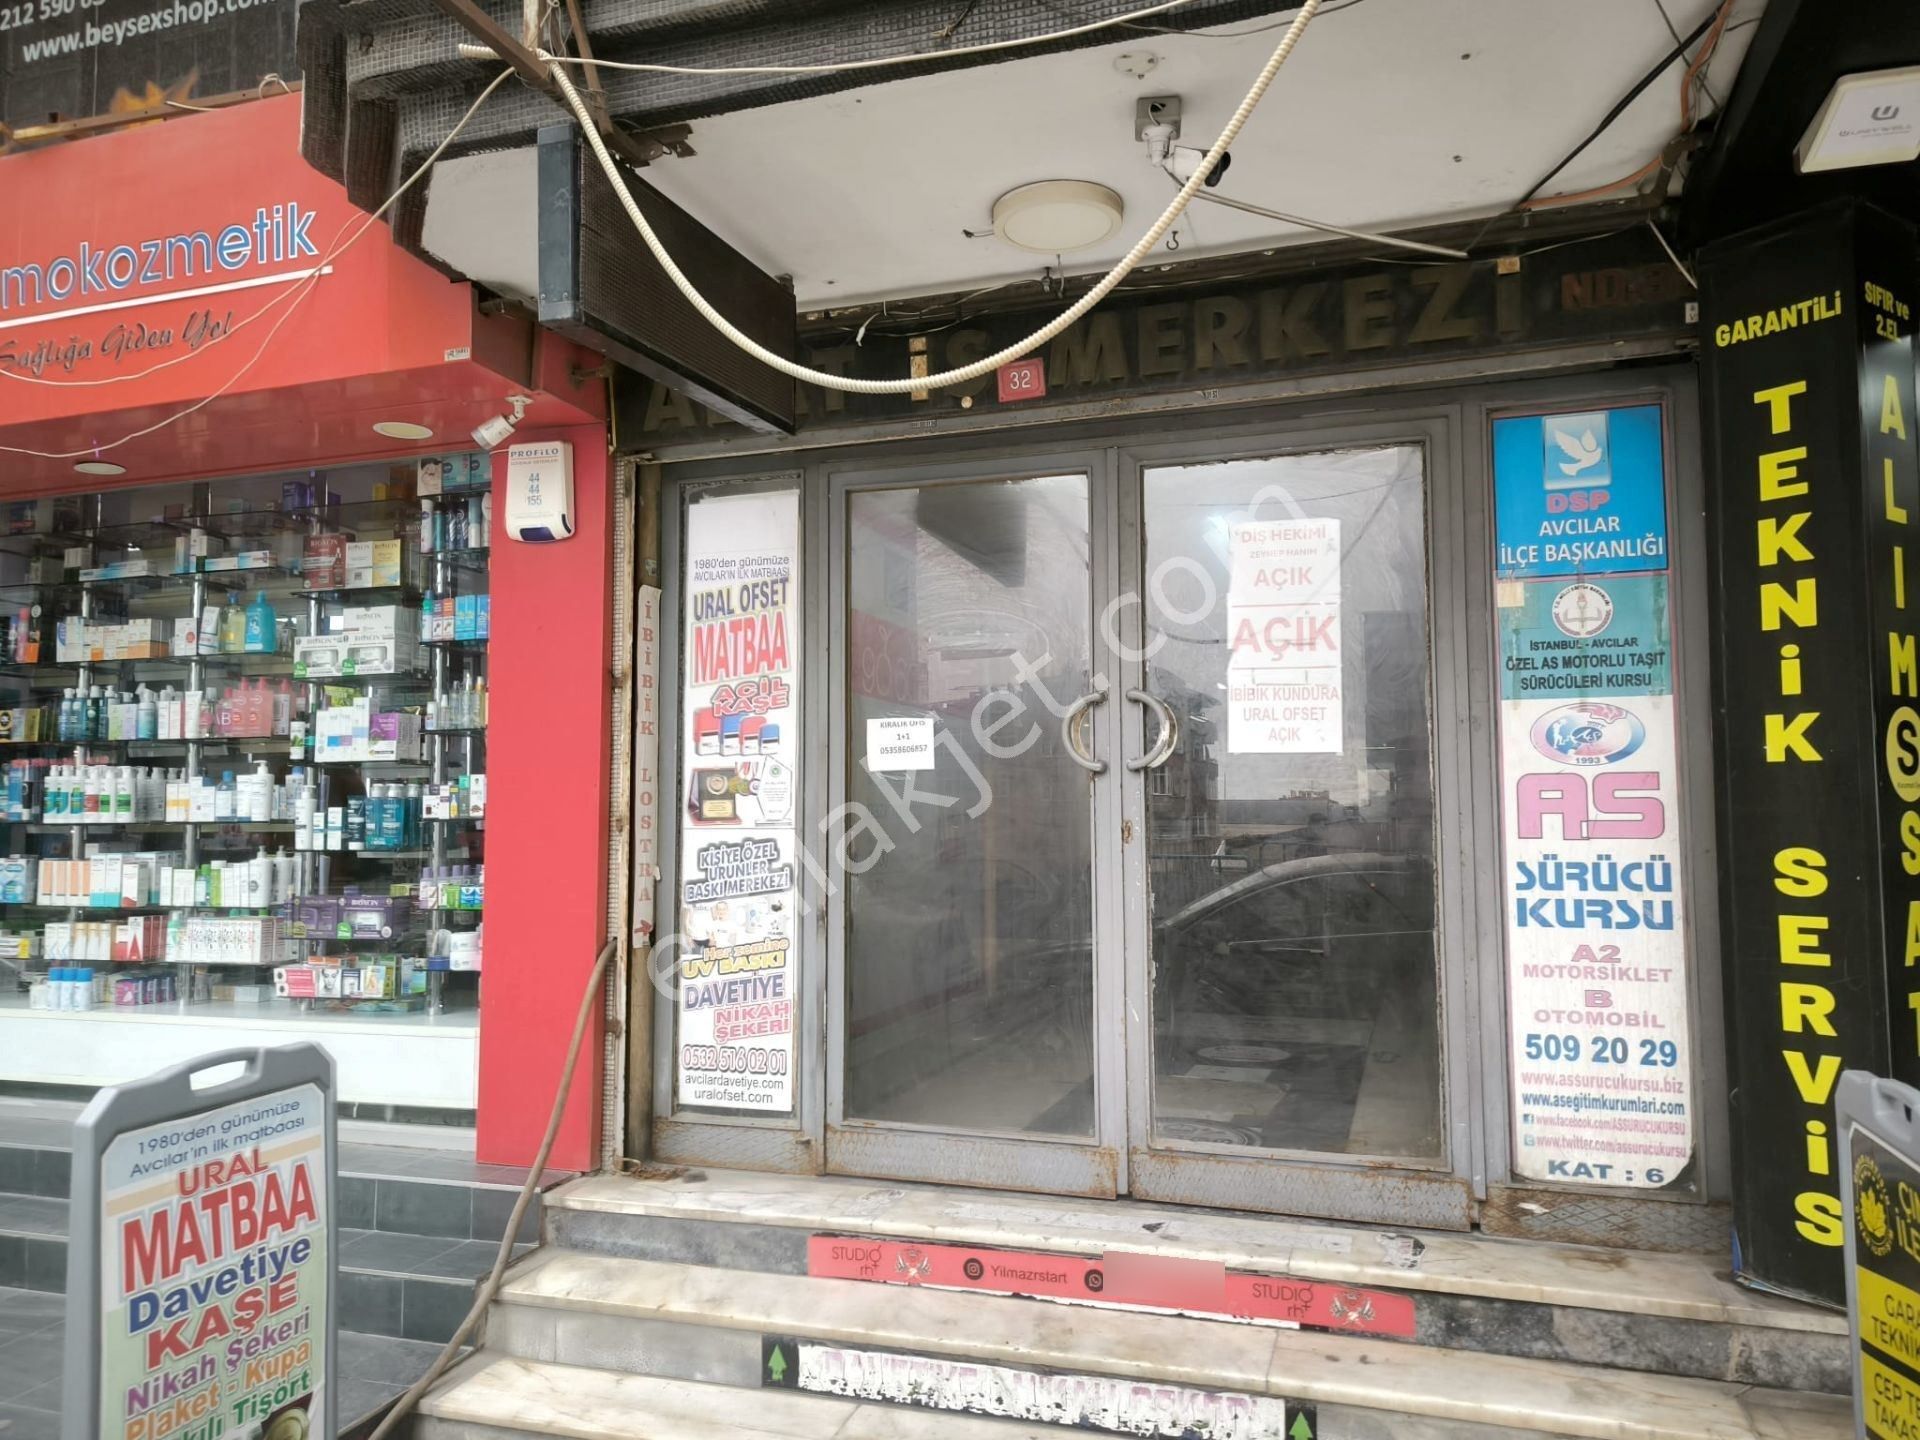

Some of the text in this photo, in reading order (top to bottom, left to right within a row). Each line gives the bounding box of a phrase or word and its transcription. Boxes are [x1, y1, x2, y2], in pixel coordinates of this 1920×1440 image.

[1010, 371, 1032, 389] 32
[528, 473, 540, 482] 44
[528, 484, 540, 494] 44
[527, 496, 542, 505] 155
[1546, 490, 1611, 513] DSP
[1539, 516, 1620, 536] AVCILAR
[1501, 533, 1663, 567] İLÇE BAŞKANLIĞI
[694, 556, 789, 569] 1980'den günümüze
[750, 567, 790, 578] MATBAASI
[1254, 567, 1312, 591] AÇIK
[694, 577, 789, 621] URAL OFSET
[694, 611, 788, 684] MATBAA
[1530, 640, 1582, 651] İSTANBUL
[1591, 637, 1638, 648] AVCILAR
[1506, 652, 1666, 671] ÖZEL AS MOTORLU TAŞIT
[1273, 684, 1339, 700] KUNDURA
[1521, 673, 1652, 690] SÜRÜCÜLERİ KURSU
[1243, 707, 1327, 721] URAL OFSET
[1268, 727, 1300, 746] AÇIK
[1516, 854, 1673, 893] SÜRÜCÜ
[1516, 898, 1674, 930] KURSU
[1571, 944, 1621, 963] A2
[681, 959, 715, 979] UV
[1523, 963, 1672, 983] MOTORSİKLET
[685, 973, 785, 1009] DAVETİYE
[1584, 989, 1613, 1008] B
[716, 1002, 790, 1024] NİKAH
[1534, 1009, 1665, 1028] OTOMOBİL
[715, 1018, 790, 1043] ŞEKERİ
[683, 1046, 786, 1074] 0532 516 02 01
[1525, 1033, 1677, 1067] 509 20 29
[685, 1074, 784, 1091] avcilardavetiye.com
[695, 1089, 773, 1104] uralofset.com
[138, 1101, 300, 1155] 1980'den günümüze
[233, 1116, 305, 1145] matbaası
[179, 1147, 269, 1198] URAL
[1548, 1160, 1613, 1179] KAT
[1645, 1168, 1665, 1183] 6
[123, 1163, 317, 1294] MATBAA
[832, 1245, 882, 1263] STUDIO
[129, 1236, 311, 1334] Davetiye
[148, 1271, 298, 1370] KAŞE
[127, 1306, 310, 1417] Nikah Şekeri
[126, 1381, 221, 1440] Plaket
[245, 1341, 310, 1391] Kupa
[1874, 1372, 1902, 1405] CEP
